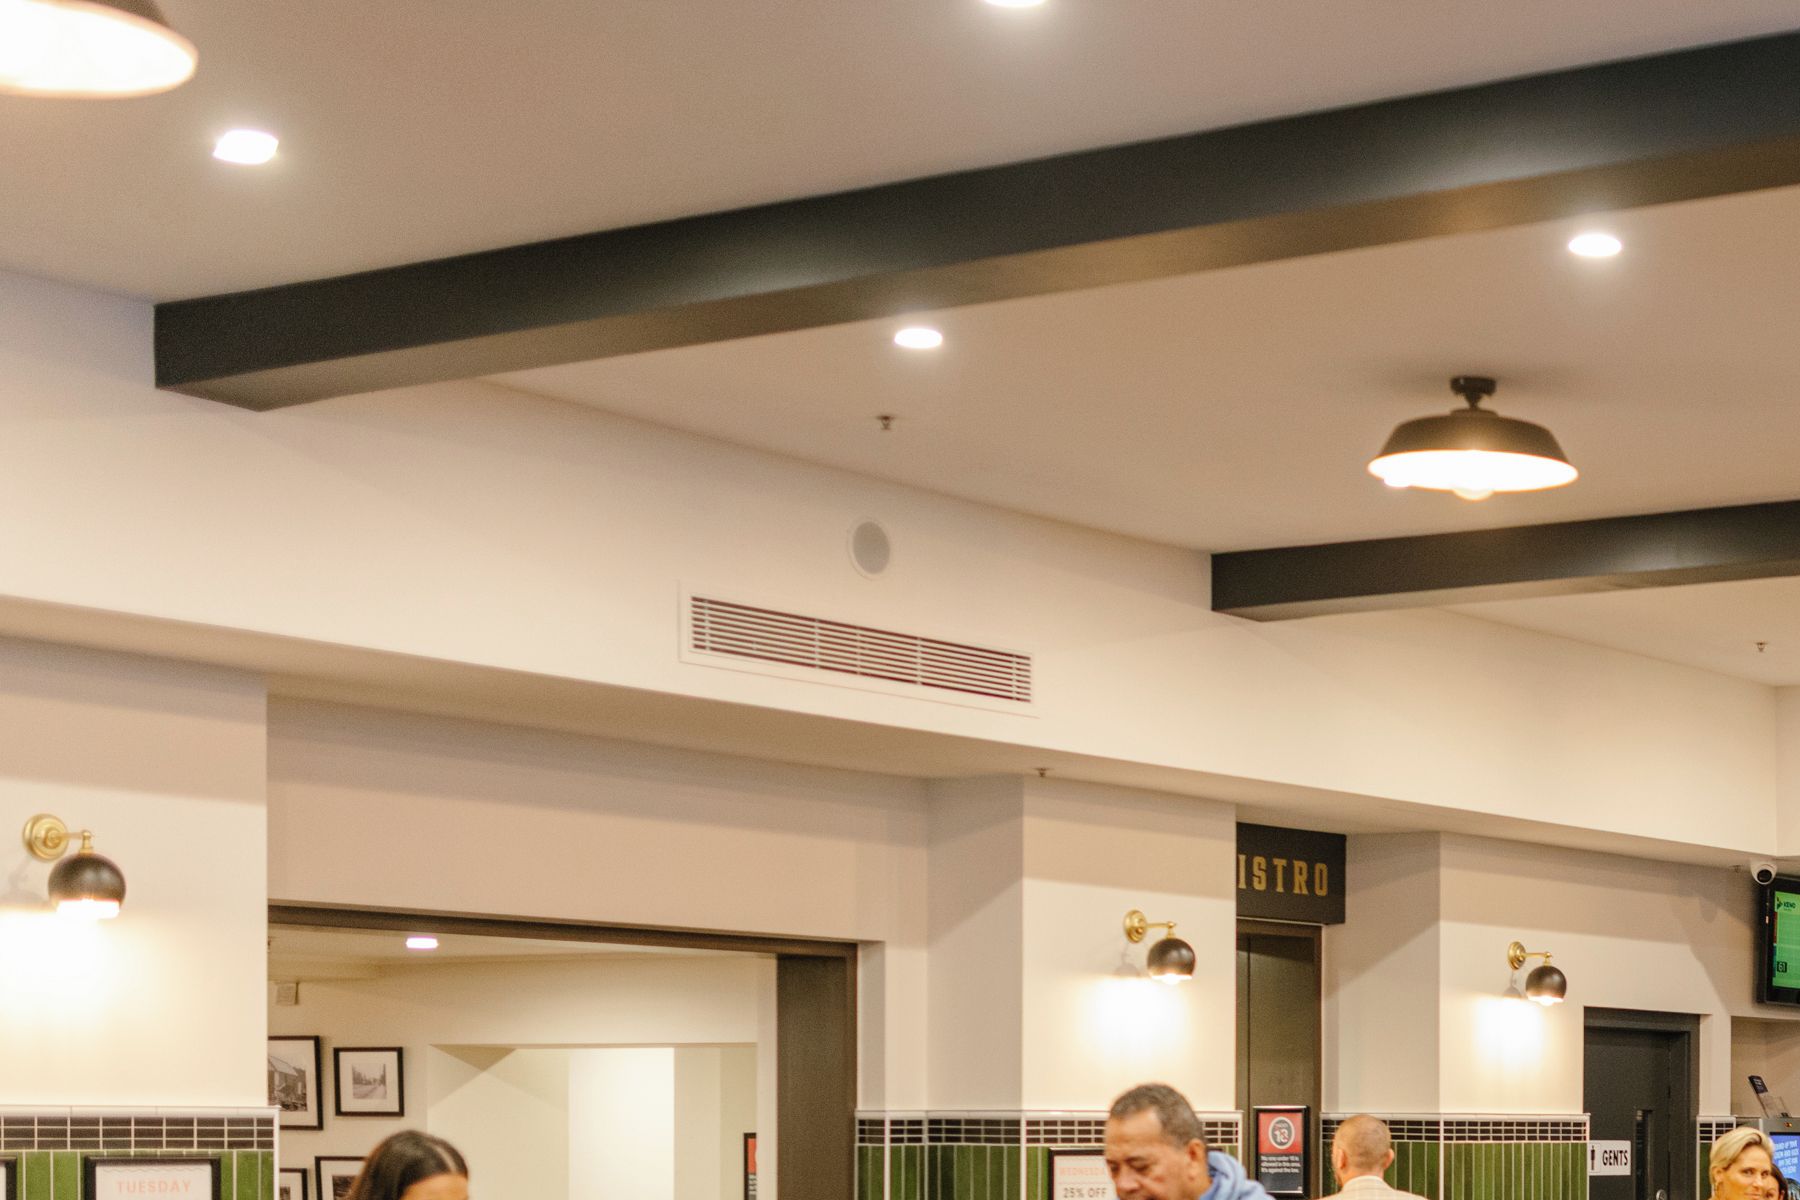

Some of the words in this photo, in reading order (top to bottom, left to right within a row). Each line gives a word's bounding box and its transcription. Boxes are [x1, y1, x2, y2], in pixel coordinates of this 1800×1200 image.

[1238, 854, 1328, 896] ISTRO
[1603, 1150, 1628, 1166] GENTS
[1059, 1168, 1105, 1176] WEDNESDA
[116, 1180, 193, 1194] TUESDAY
[1063, 1187, 1084, 1198] 25%
[1088, 1187, 1107, 1197] OFF
